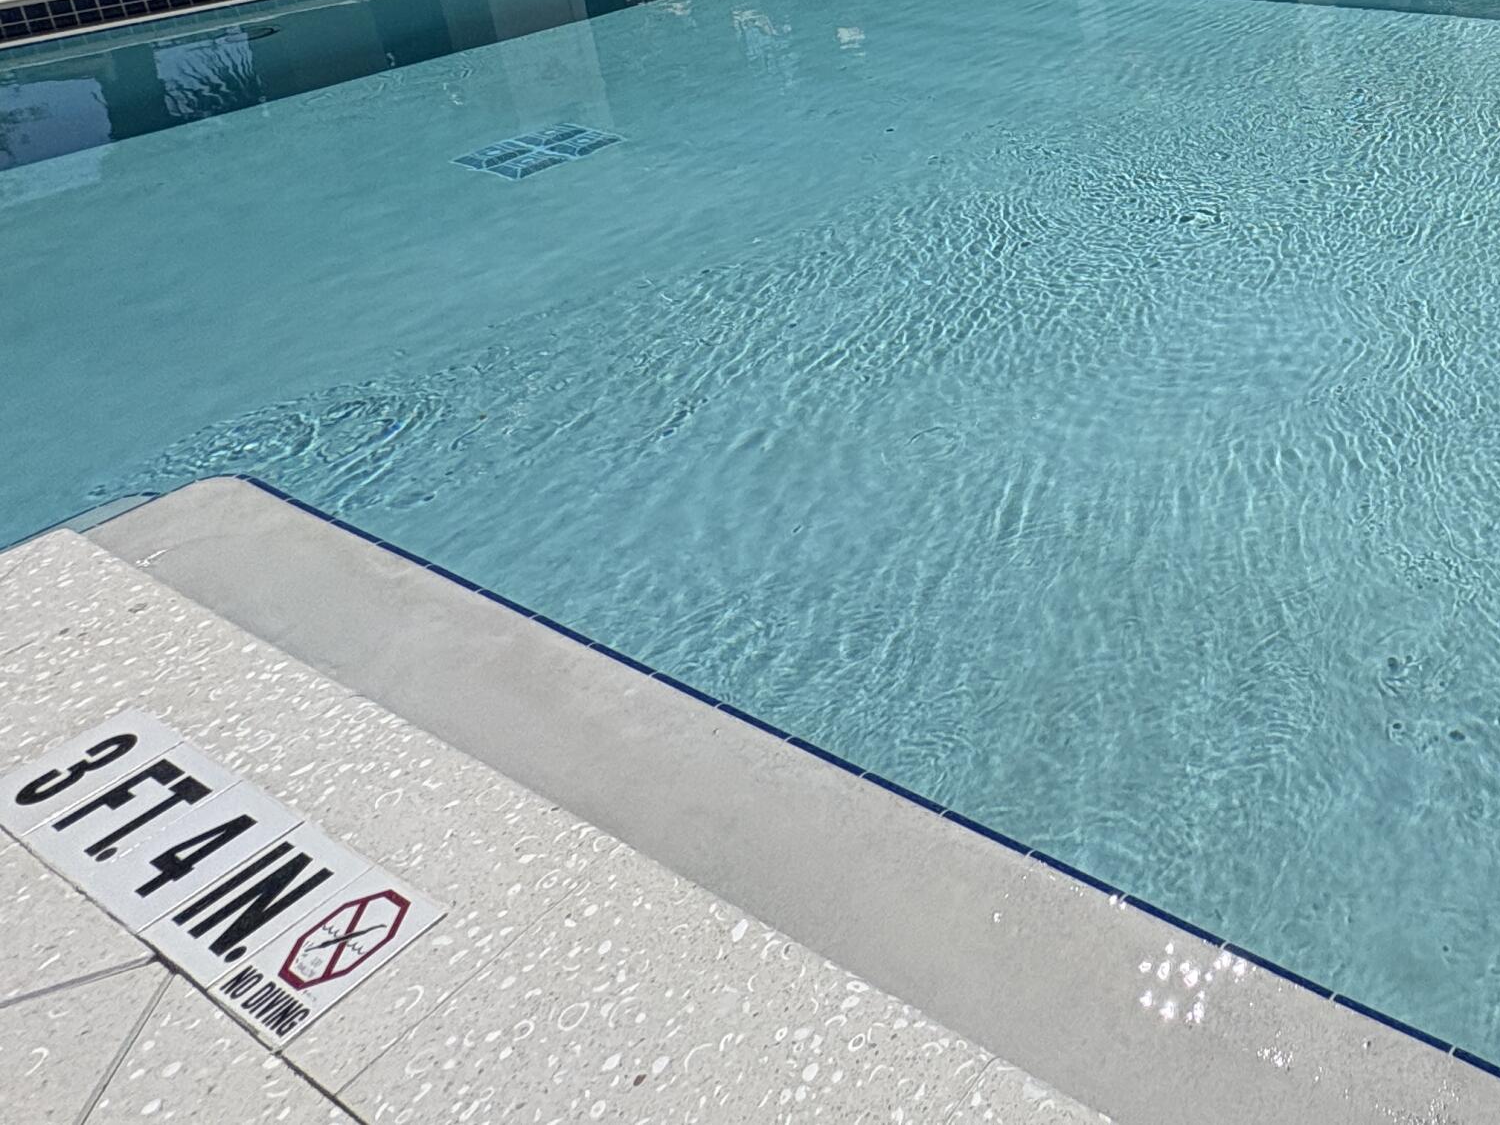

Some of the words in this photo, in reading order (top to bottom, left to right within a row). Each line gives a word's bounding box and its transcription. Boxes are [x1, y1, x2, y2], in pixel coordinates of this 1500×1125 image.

[14, 733, 138, 807] 3
[51, 758, 213, 863] FT.
[134, 813, 258, 899] 4
[171, 840, 335, 964] IN.
[219, 964, 264, 1000] NO
[240, 980, 310, 1038] DIVING
